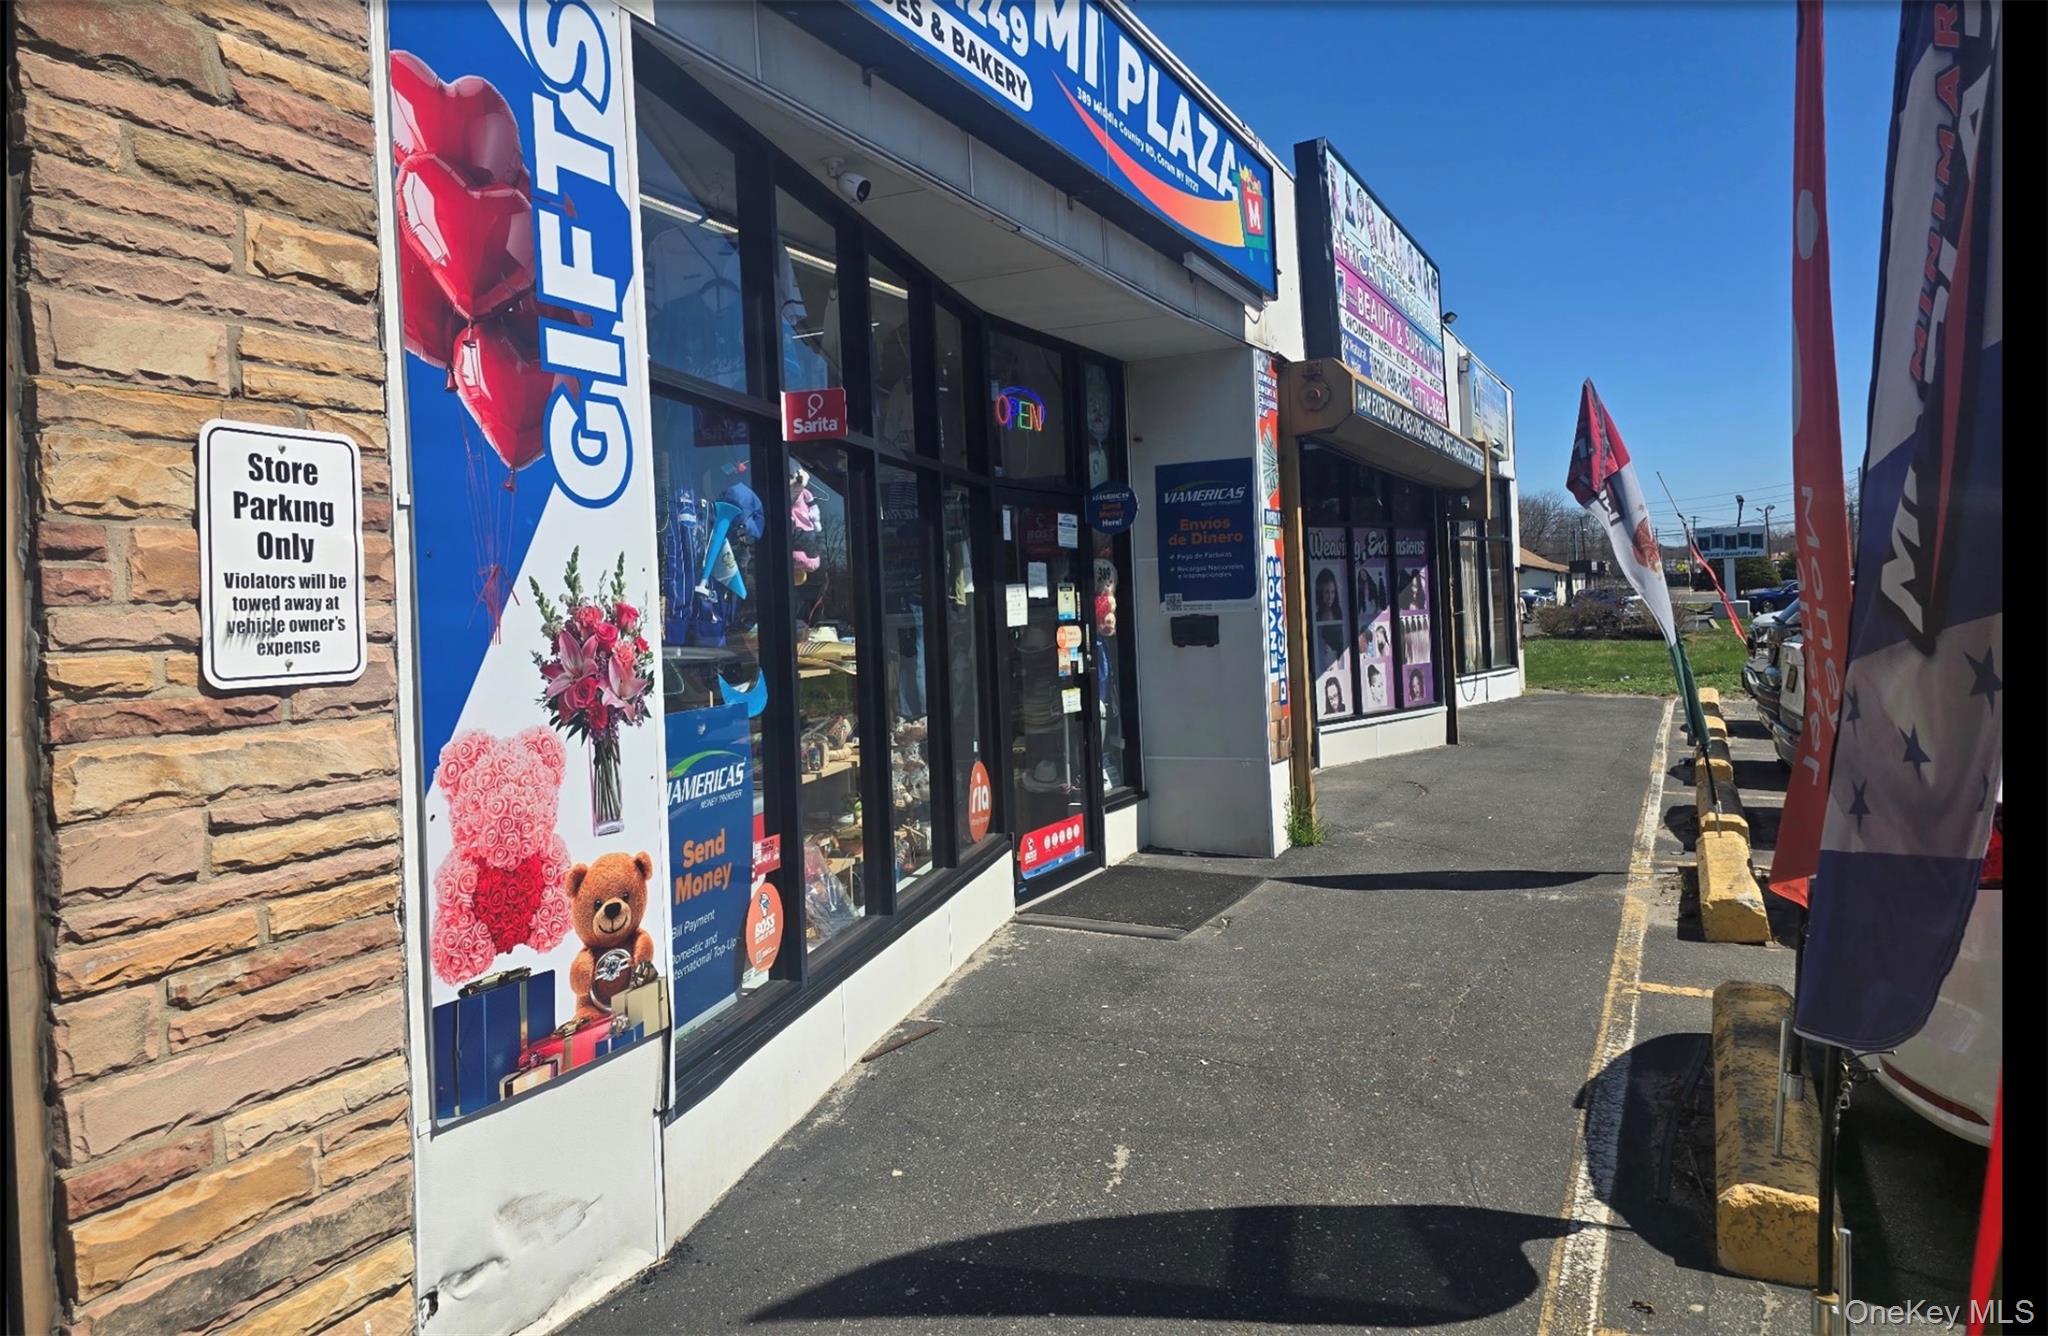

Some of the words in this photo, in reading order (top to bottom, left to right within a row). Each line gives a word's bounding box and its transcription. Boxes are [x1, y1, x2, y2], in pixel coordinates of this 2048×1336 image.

[931, 12, 944, 43] &
[951, 26, 1028, 102] BAKERY
[1034, 0, 1098, 88] MI
[1117, 35, 1239, 200] PLAZA
[1077, 86, 1092, 107] 389
[1093, 98, 1118, 128] Middle
[1119, 120, 1145, 152] Country
[1157, 152, 1176, 175] Coram
[520, 0, 633, 509] GIFTS
[1357, 286, 1395, 338] BEAUTY
[1345, 313, 1374, 345] WOMEN
[793, 417, 839, 434] Sarita
[995, 392, 1044, 432] OPEN
[248, 452, 319, 486] Store
[233, 490, 335, 528] Parking
[1163, 486, 1245, 504] VIAMERICAS
[257, 531, 315, 563] Only
[1168, 534, 1187, 546] de
[1191, 532, 1244, 545] Dinero
[223, 572, 296, 590] Violators
[299, 573, 326, 589] will
[329, 573, 347, 590] be
[232, 595, 281, 612] towed
[284, 598, 323, 612] away
[325, 596, 340, 611] at
[1802, 486, 1840, 733] Money
[226, 617, 286, 635] vehicle
[288, 615, 346, 633] owner's
[257, 640, 321, 657] expense
[668, 762, 745, 806] IAMERICAS
[971, 783, 990, 814] ria
[682, 828, 726, 869] Send
[675, 862, 732, 905] Money
[684, 909, 715, 934] Payment
[704, 931, 718, 949] and
[714, 937, 737, 958] Top-Up
